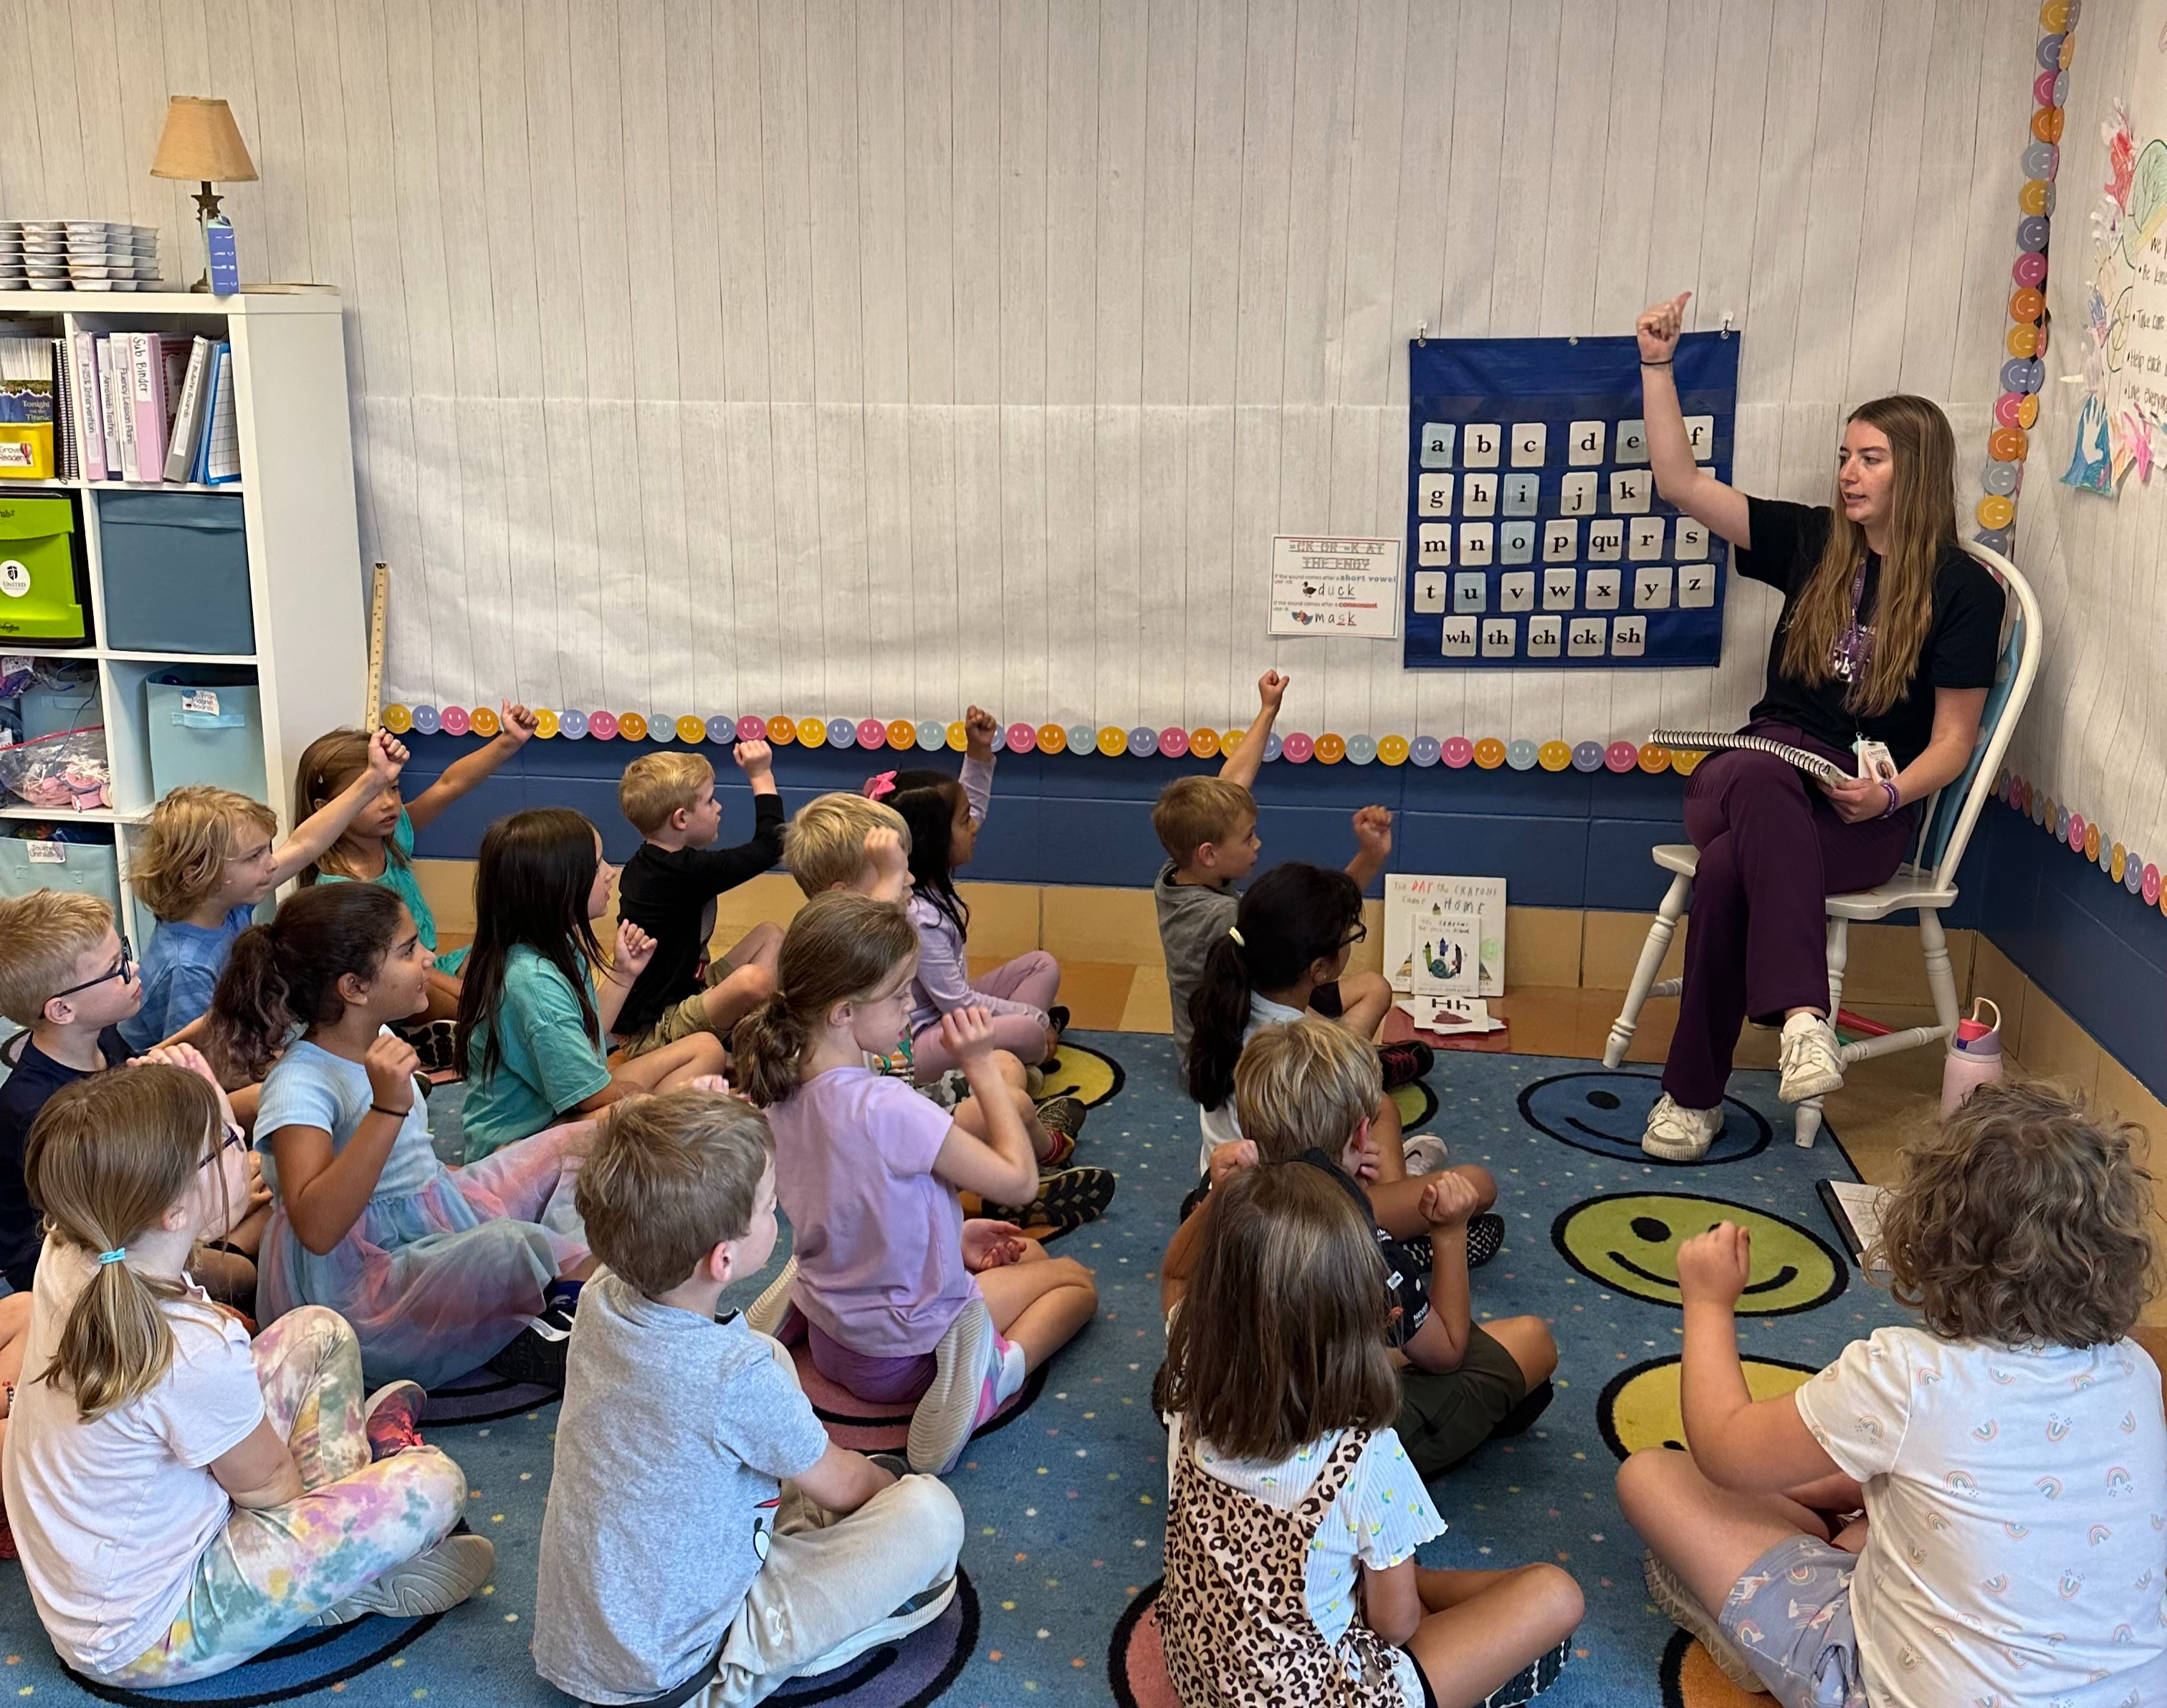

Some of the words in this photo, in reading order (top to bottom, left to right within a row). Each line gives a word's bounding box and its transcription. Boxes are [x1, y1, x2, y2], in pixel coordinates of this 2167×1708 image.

[2136, 309, 2151, 330] Take
[2152, 314, 2165, 330] care
[133, 337, 146, 358] Sub
[2130, 349, 2144, 374] Help
[2147, 355, 2161, 373] each
[120, 368, 129, 395] Fluency
[136, 362, 150, 395] Binder
[2128, 380, 2140, 402] Love
[23, 400, 50, 409] Tonight
[84, 387, 95, 433] Intervention
[123, 397, 132, 424] Lesson
[125, 426, 134, 445] Plans
[1430, 439, 1445, 453] a
[1477, 434, 1492, 453] b
[1524, 439, 1536, 453] c
[1581, 432, 1597, 451] d
[1627, 436, 1640, 448] e
[1690, 427, 1704, 446] f
[1430, 490, 1445, 508] g
[1473, 484, 1488, 502] h
[1518, 484, 1526, 502] i
[1572, 487, 1583, 511] j
[1620, 481, 1636, 499] k
[1321, 542, 1338, 553] OR
[1367, 543, 1384, 555] AT
[1425, 539, 1447, 552] m
[1470, 539, 1486, 551] n
[1512, 537, 1526, 550] o
[1552, 536, 1569, 553] p
[1592, 535, 1620, 552] qu
[1640, 534, 1655, 546] r
[1685, 531, 1698, 544] s
[1303, 557, 1329, 569] THE
[1426, 585, 1436, 599] t
[1463, 587, 1478, 600] u
[1510, 587, 1524, 599] v
[1549, 585, 1571, 597] w
[1597, 585, 1611, 596] x
[1645, 583, 1659, 600] y
[1689, 578, 1700, 590] z
[1446, 630, 1471, 643] wh
[1488, 630, 1509, 645] th
[1532, 630, 1556, 644] ch
[1573, 629, 1597, 644] ck
[1616, 628, 1641, 643] sh
[1411, 881, 1434, 893] DAY
[1437, 882, 1449, 893] the
[1454, 884, 1498, 896] CRAYONS
[1444, 897, 1486, 915] HOME
